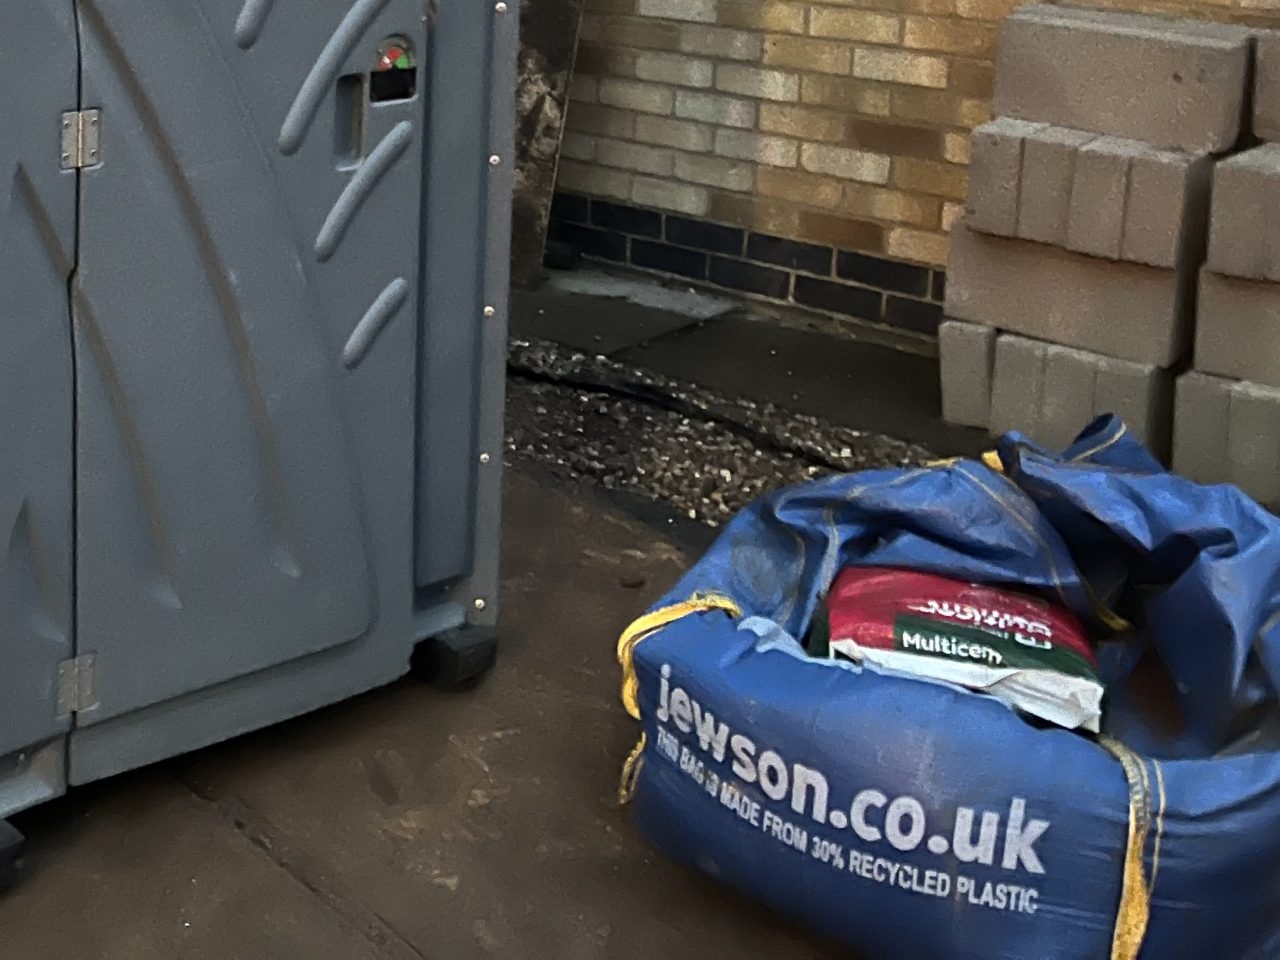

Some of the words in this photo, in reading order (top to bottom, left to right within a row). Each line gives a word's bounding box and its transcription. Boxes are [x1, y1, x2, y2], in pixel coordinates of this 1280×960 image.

[902, 630, 1003, 664] Multicem
[656, 663, 1052, 874] jewson.co.uk
[680, 746, 705, 785] BAG
[720, 781, 761, 827] MADE
[763, 810, 807, 853] FROM
[812, 836, 844, 870] 30%
[849, 850, 951, 897] RECYCLED
[956, 875, 1039, 914] PLASTIC
